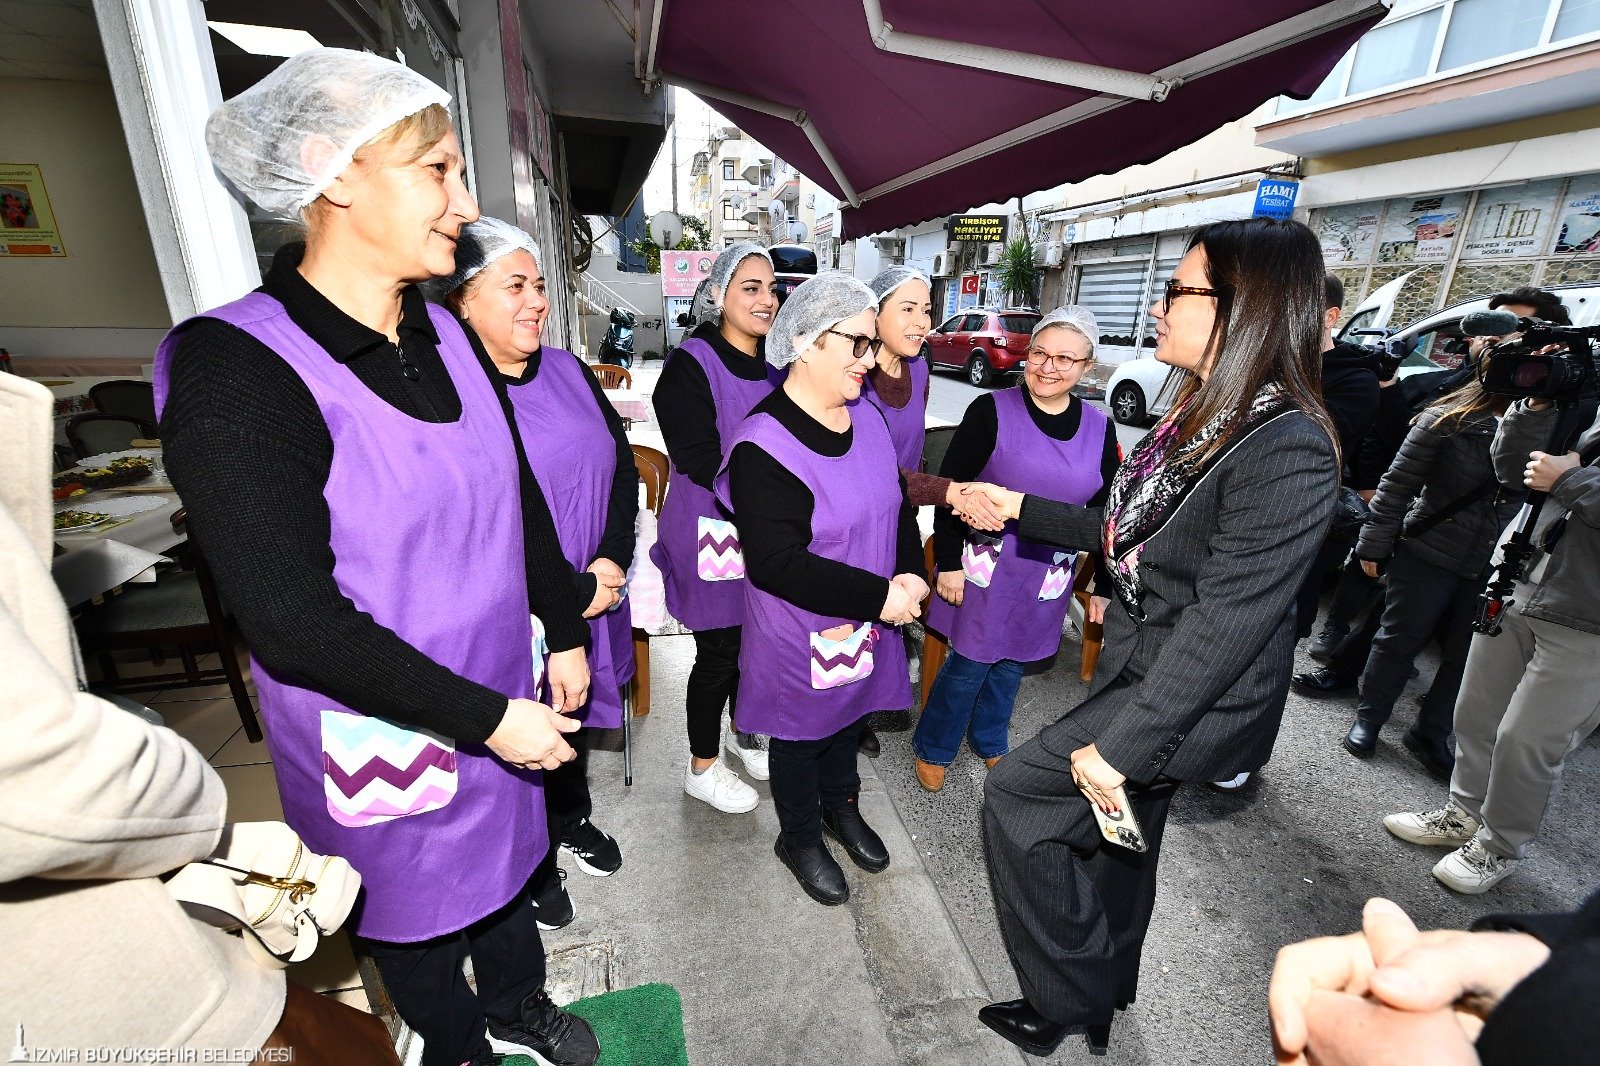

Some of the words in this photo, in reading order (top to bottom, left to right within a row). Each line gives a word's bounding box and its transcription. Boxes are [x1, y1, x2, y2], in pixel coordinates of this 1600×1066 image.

[1260, 185, 1295, 200] HAMİ
[1262, 198, 1290, 207] TESİSAT
[960, 218, 999, 226] TİRBİŞON
[954, 226, 1003, 234] NAKLİYAT
